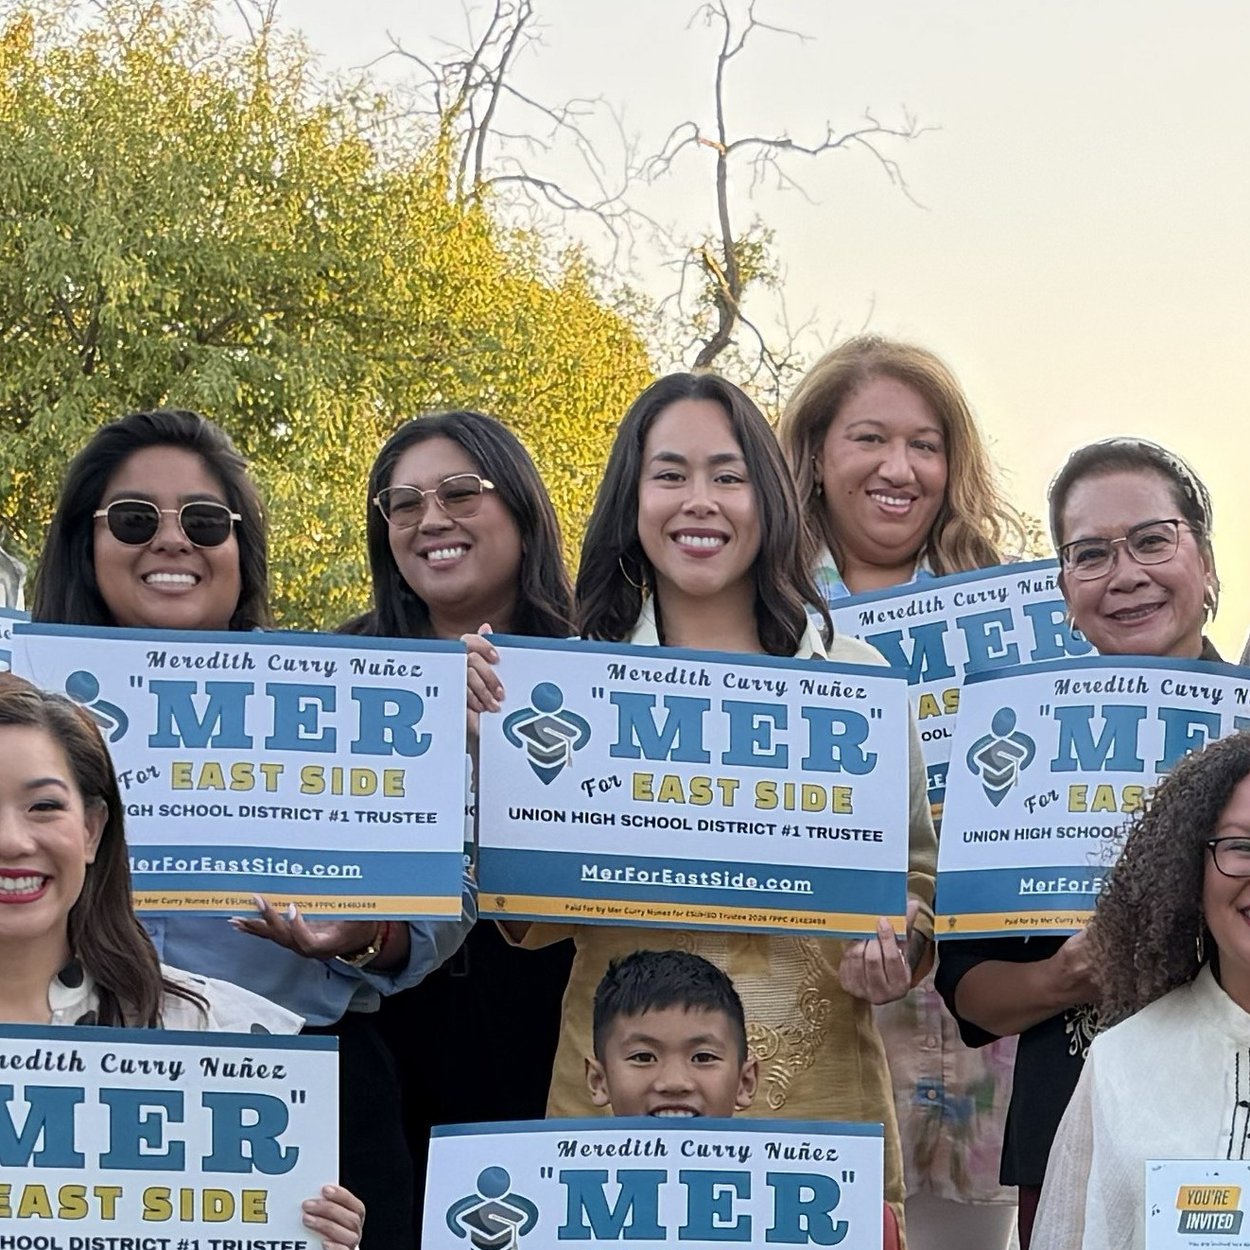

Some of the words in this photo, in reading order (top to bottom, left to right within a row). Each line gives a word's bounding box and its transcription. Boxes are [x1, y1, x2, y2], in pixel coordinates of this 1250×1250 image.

[859, 595, 944, 626] Meredith
[954, 586, 1009, 606] Curry
[146, 651, 256, 670] Meredith
[268, 654, 337, 677] Curry
[351, 658, 423, 677] Nuñez
[607, 663, 712, 687] Meredith
[724, 673, 788, 696] Curry
[800, 679, 867, 700] Nuñez
[1055, 675, 1149, 696] Meredith
[1161, 679, 1224, 704] Curry
[129, 676, 438, 757] "MER"
[591, 687, 882, 776] "MER"
[118, 766, 160, 789] For
[171, 762, 283, 792] EAST
[300, 766, 406, 797] SIDE
[581, 775, 622, 798] For
[633, 773, 740, 806] EAST
[755, 782, 854, 814] SIDE
[159, 804, 232, 817] SCHOOL
[239, 805, 323, 821] DISTRICT
[329, 810, 349, 823] #1
[355, 811, 437, 824] TRUSTEE
[1024, 790, 1059, 814] For
[1068, 785, 1146, 813] EAS
[508, 807, 566, 823] UNION
[571, 812, 615, 826] HIGH
[621, 814, 692, 832] SCHOOL
[698, 820, 777, 836] DISTRICT
[782, 826, 801, 837] #1
[806, 827, 883, 843] TRUSTEE
[963, 829, 1009, 843] UNION
[1014, 827, 1051, 840] HIGH
[1057, 826, 1124, 839] SCHOOL
[582, 865, 813, 893] MerForEastSide.com
[100, 1053, 186, 1081] Curry
[200, 1057, 287, 1079] Nuñez
[0, 1085, 305, 1175] MER"
[557, 1139, 668, 1158] Meredith
[681, 1140, 752, 1163] Curry
[765, 1141, 839, 1161] Nuñez
[143, 1187, 268, 1223] SIDE
[540, 1167, 854, 1246] "MER"
[1187, 1190, 1230, 1205] YOU'RE
[1186, 1213, 1234, 1229] INVITED
[0, 1236, 62, 1250] HOOL
